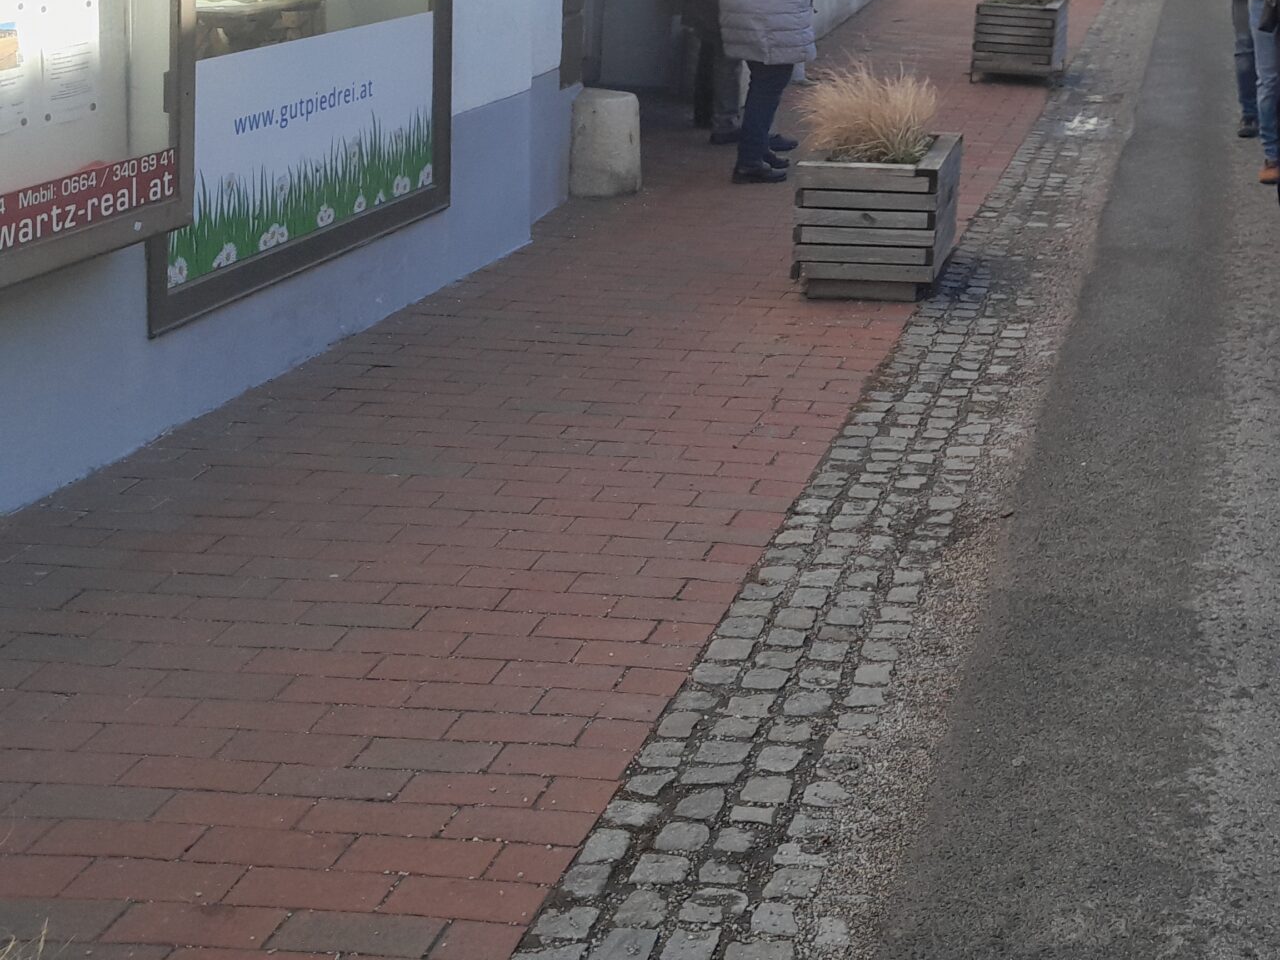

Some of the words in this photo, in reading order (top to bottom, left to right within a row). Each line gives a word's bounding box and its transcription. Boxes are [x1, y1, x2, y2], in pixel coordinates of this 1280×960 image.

[234, 80, 373, 135] www.gutpiedrei.at
[19, 183, 57, 209] Mobil:
[61, 171, 97, 196] 0664
[113, 160, 138, 181] 340
[141, 154, 157, 173] 69
[160, 149, 175, 166] 41
